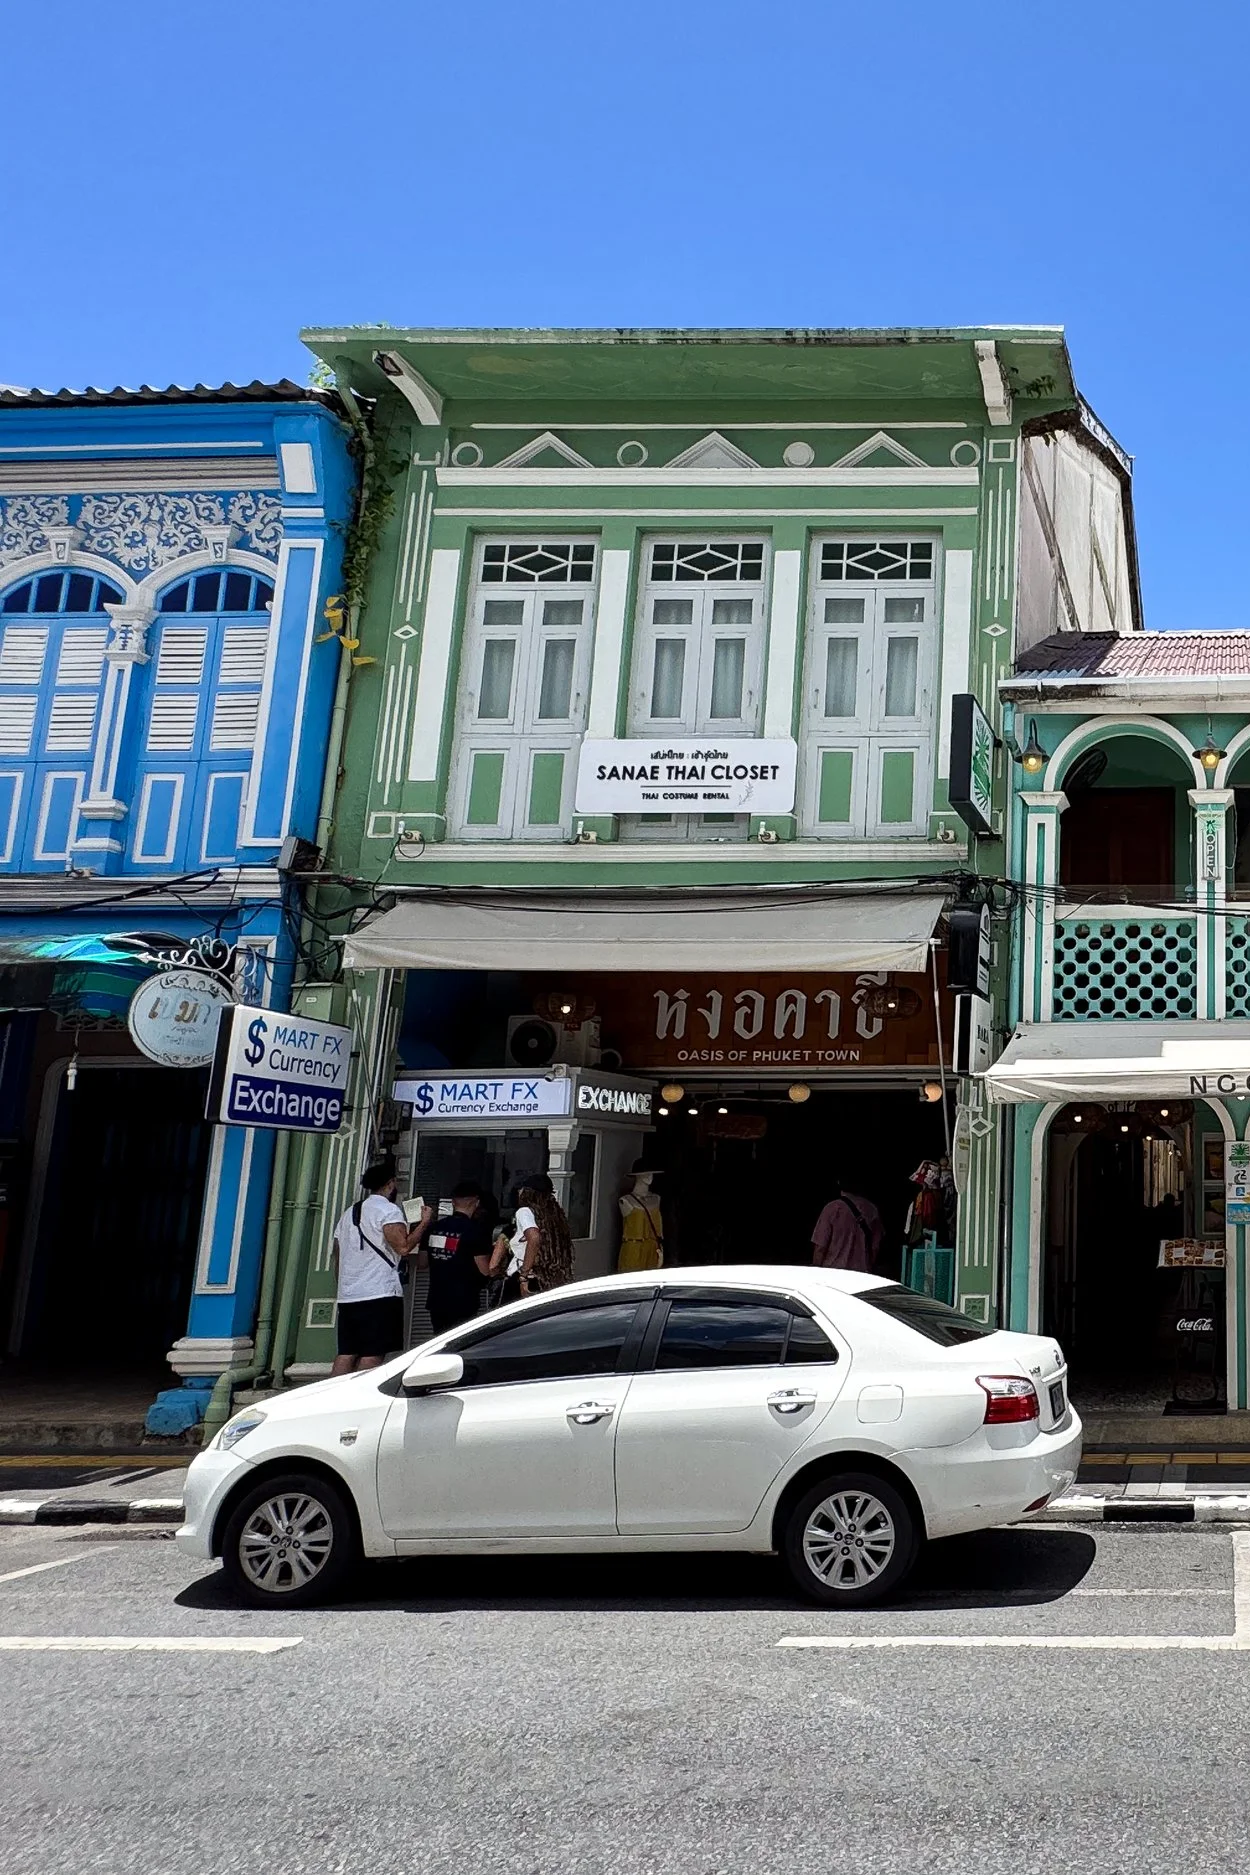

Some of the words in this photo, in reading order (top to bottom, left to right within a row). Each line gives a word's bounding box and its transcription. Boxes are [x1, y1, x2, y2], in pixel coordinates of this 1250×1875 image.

[596, 765, 660, 780] SANAE
[666, 765, 705, 780] THAI
[711, 764, 779, 780] CLOSET
[641, 792, 659, 800] THAI
[662, 792, 698, 800] COSTUME
[703, 792, 730, 800] RENTAL
[1206, 833, 1216, 878] OPEN
[273, 1025, 320, 1050] MART
[322, 1035, 343, 1056] FX
[269, 1049, 341, 1083] Currency
[677, 1050, 724, 1061] OASIS
[727, 1050, 748, 1061] OF
[752, 1050, 811, 1061] PHUKET
[816, 1050, 860, 1061] TOWN
[233, 1079, 341, 1127] Exchange
[440, 1083, 503, 1101] MART
[511, 1082, 539, 1100] FX
[579, 1085, 652, 1115] EXCHANGE
[438, 1102, 484, 1113] Currency
[489, 1101, 539, 1113] Exchange
